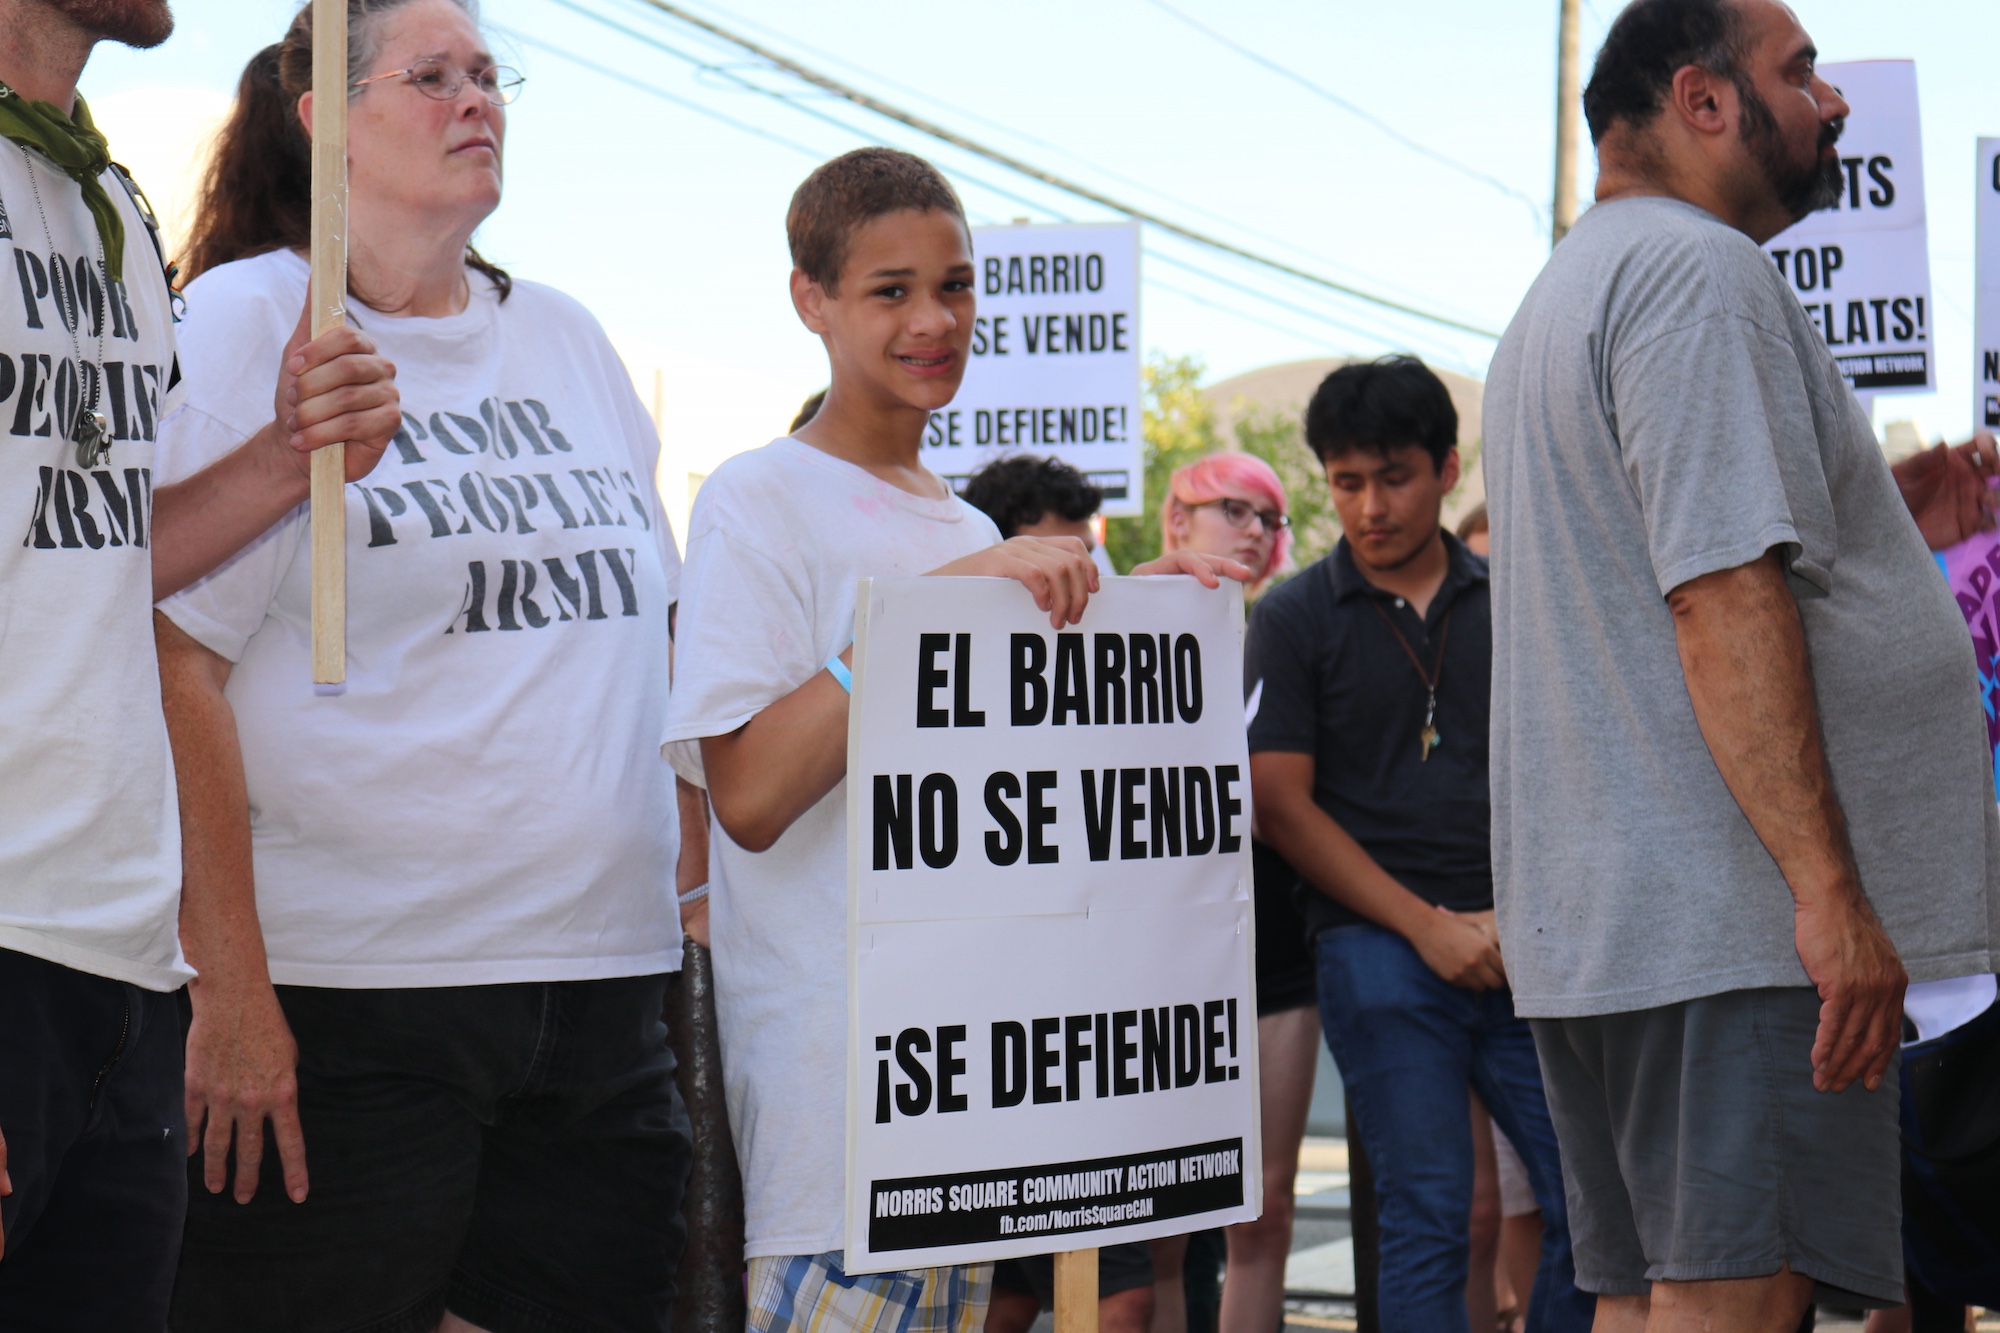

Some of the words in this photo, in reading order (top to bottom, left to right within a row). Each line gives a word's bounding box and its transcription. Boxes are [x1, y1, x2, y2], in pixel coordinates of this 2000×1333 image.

[984, 254, 1104, 296] BARRIO
[1772, 245, 1843, 291] TOP
[971, 316, 1009, 356] SE
[1023, 313, 1129, 354] VENDE
[1874, 354, 1925, 374] NETWORK
[392, 396, 574, 466] POOR
[920, 411, 962, 450] SE
[975, 406, 1129, 447] DEFIENDE!
[22, 464, 153, 551] ARM
[353, 466, 651, 549] PEOPLE'S
[444, 548, 640, 635] ARMY
[916, 632, 986, 728] EL
[1010, 632, 1204, 727] BARRIO
[872, 772, 959, 871] NO
[983, 770, 1060, 867] SE
[1080, 764, 1243, 862] VENDE
[875, 1024, 969, 1125] ¡SE
[991, 997, 1240, 1109] DEFIENDE!
[875, 1186, 944, 1219] NORRIS
[948, 1179, 1018, 1213] SQUARE
[1022, 1167, 1124, 1205] COMMUNITY
[1127, 1159, 1176, 1192] ACTION
[1179, 1148, 1240, 1184] NETWORK
[999, 1197, 1154, 1235] fb.com/NorrisSquareCAN
